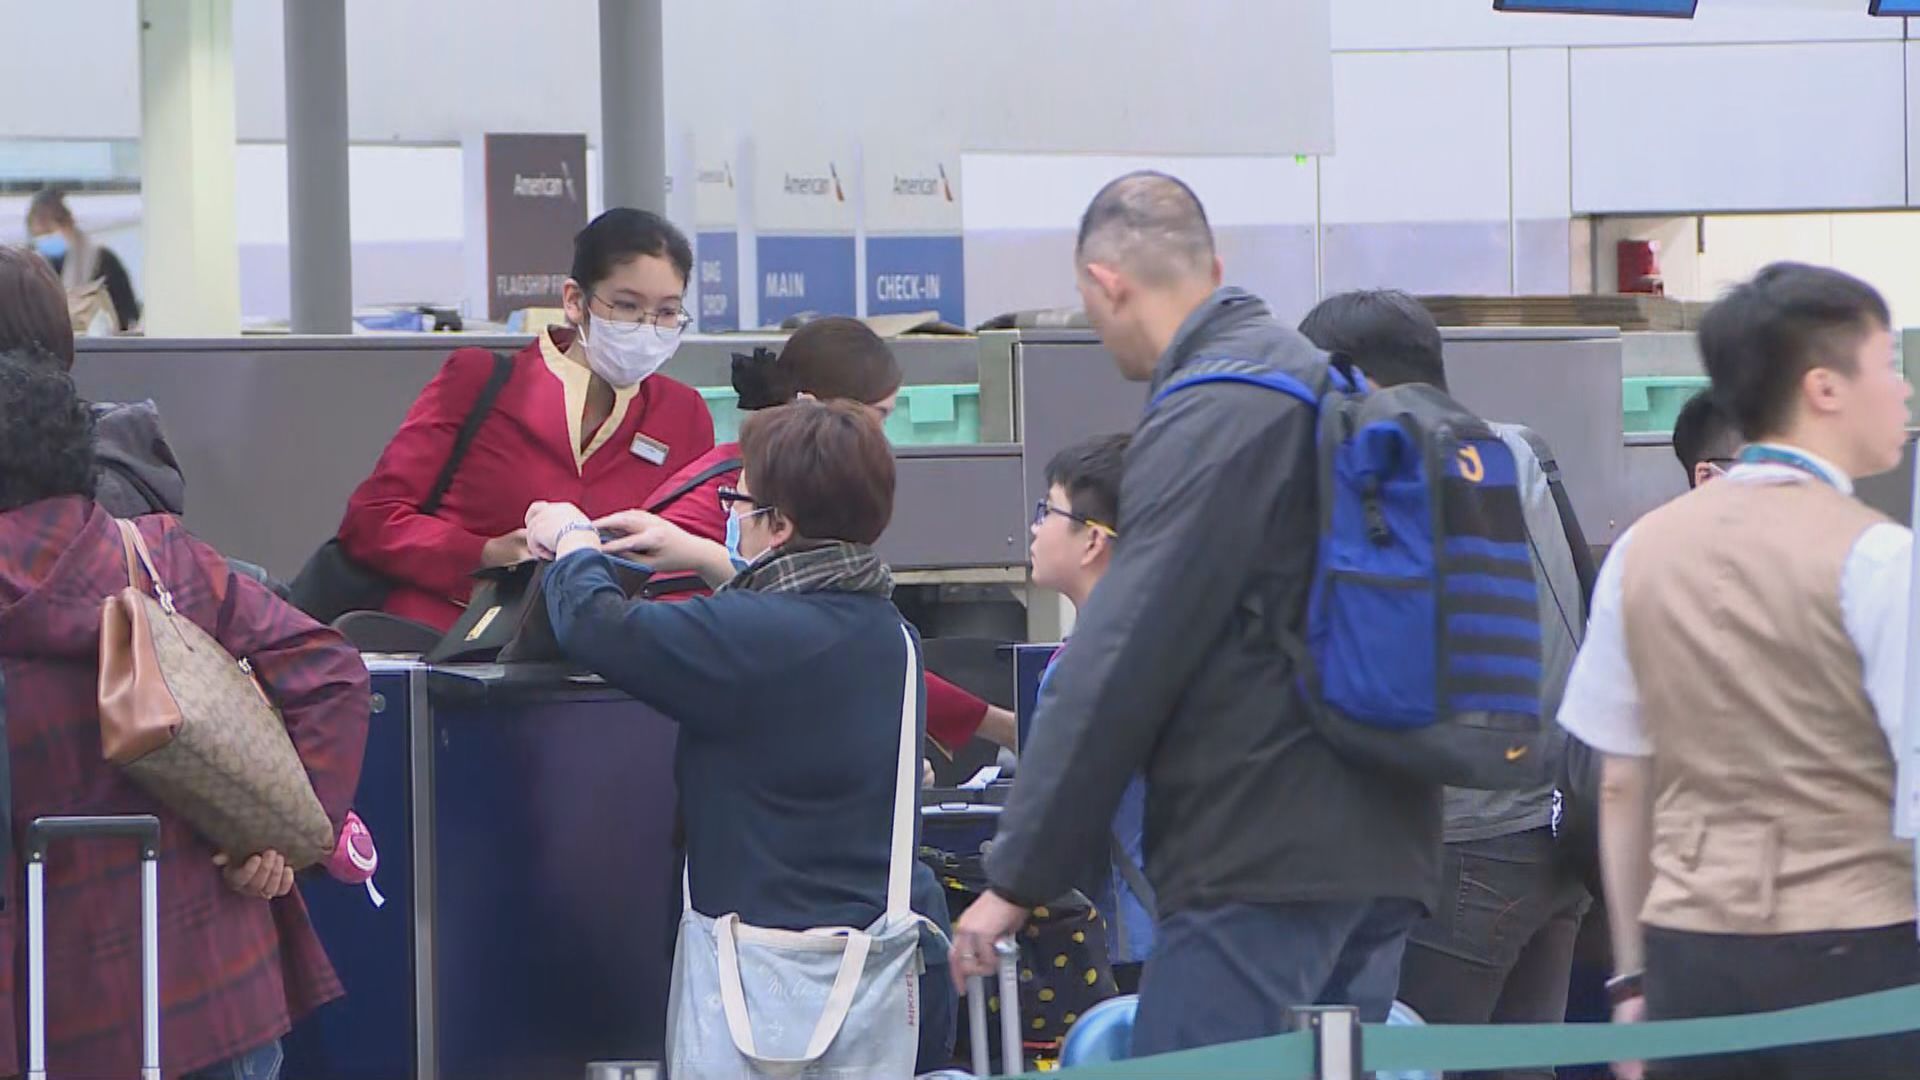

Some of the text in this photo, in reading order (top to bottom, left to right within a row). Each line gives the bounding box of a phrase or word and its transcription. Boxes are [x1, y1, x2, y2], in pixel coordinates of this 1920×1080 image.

[513, 172, 563, 196] American
[784, 173, 830, 195] American
[893, 174, 938, 195] American
[496, 274, 550, 296] FLAGSHIP
[766, 272, 805, 297] MAIN
[876, 274, 941, 300] CHECK-IN
